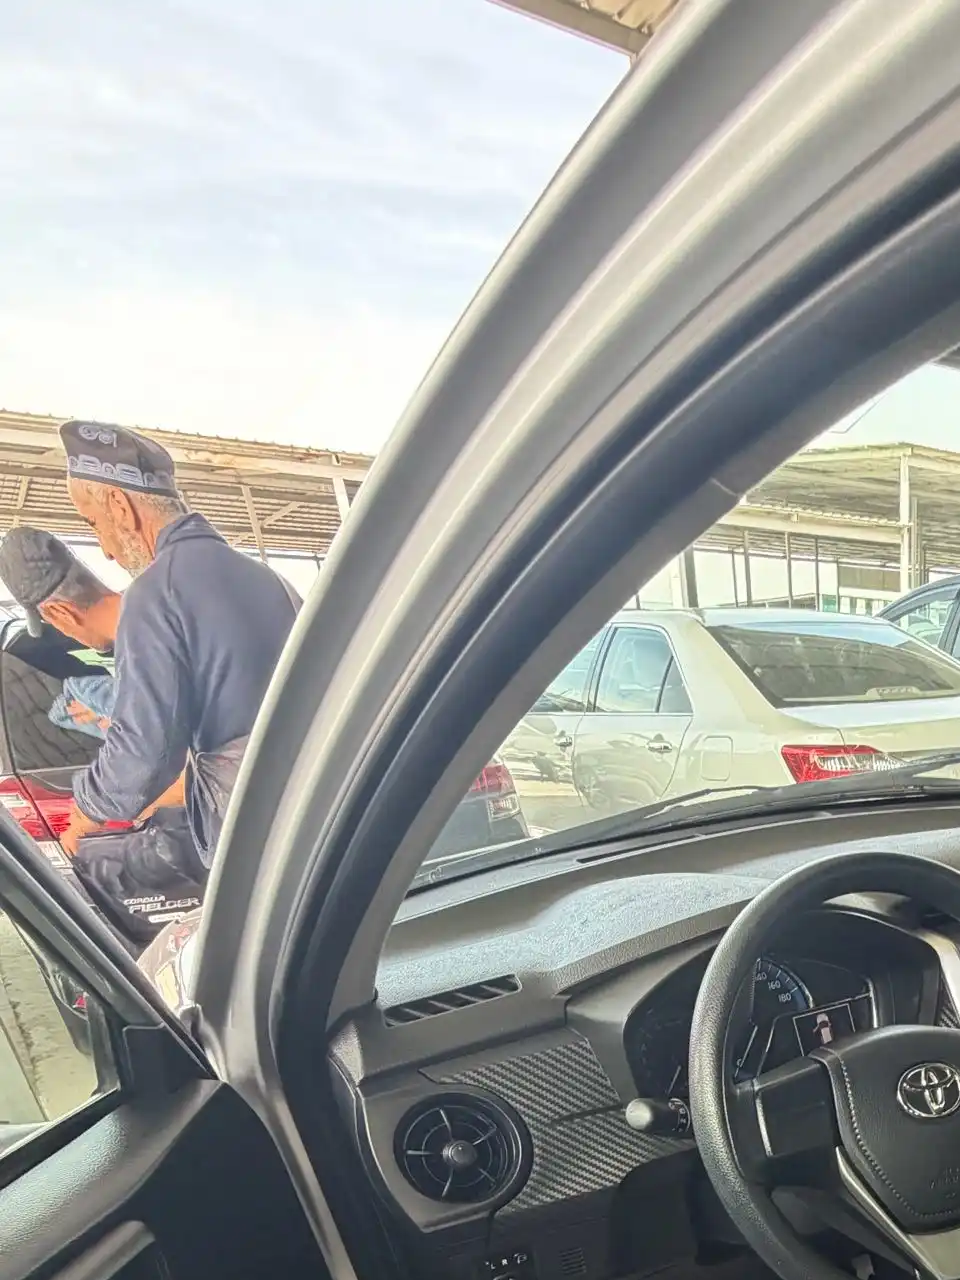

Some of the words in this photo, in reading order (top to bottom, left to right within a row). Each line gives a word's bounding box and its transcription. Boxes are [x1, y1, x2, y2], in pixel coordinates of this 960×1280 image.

[129, 897, 200, 913] FIELDER
[755, 972, 767, 980] 40
[767, 981, 780, 990] 160
[778, 993, 791, 1002] 180
